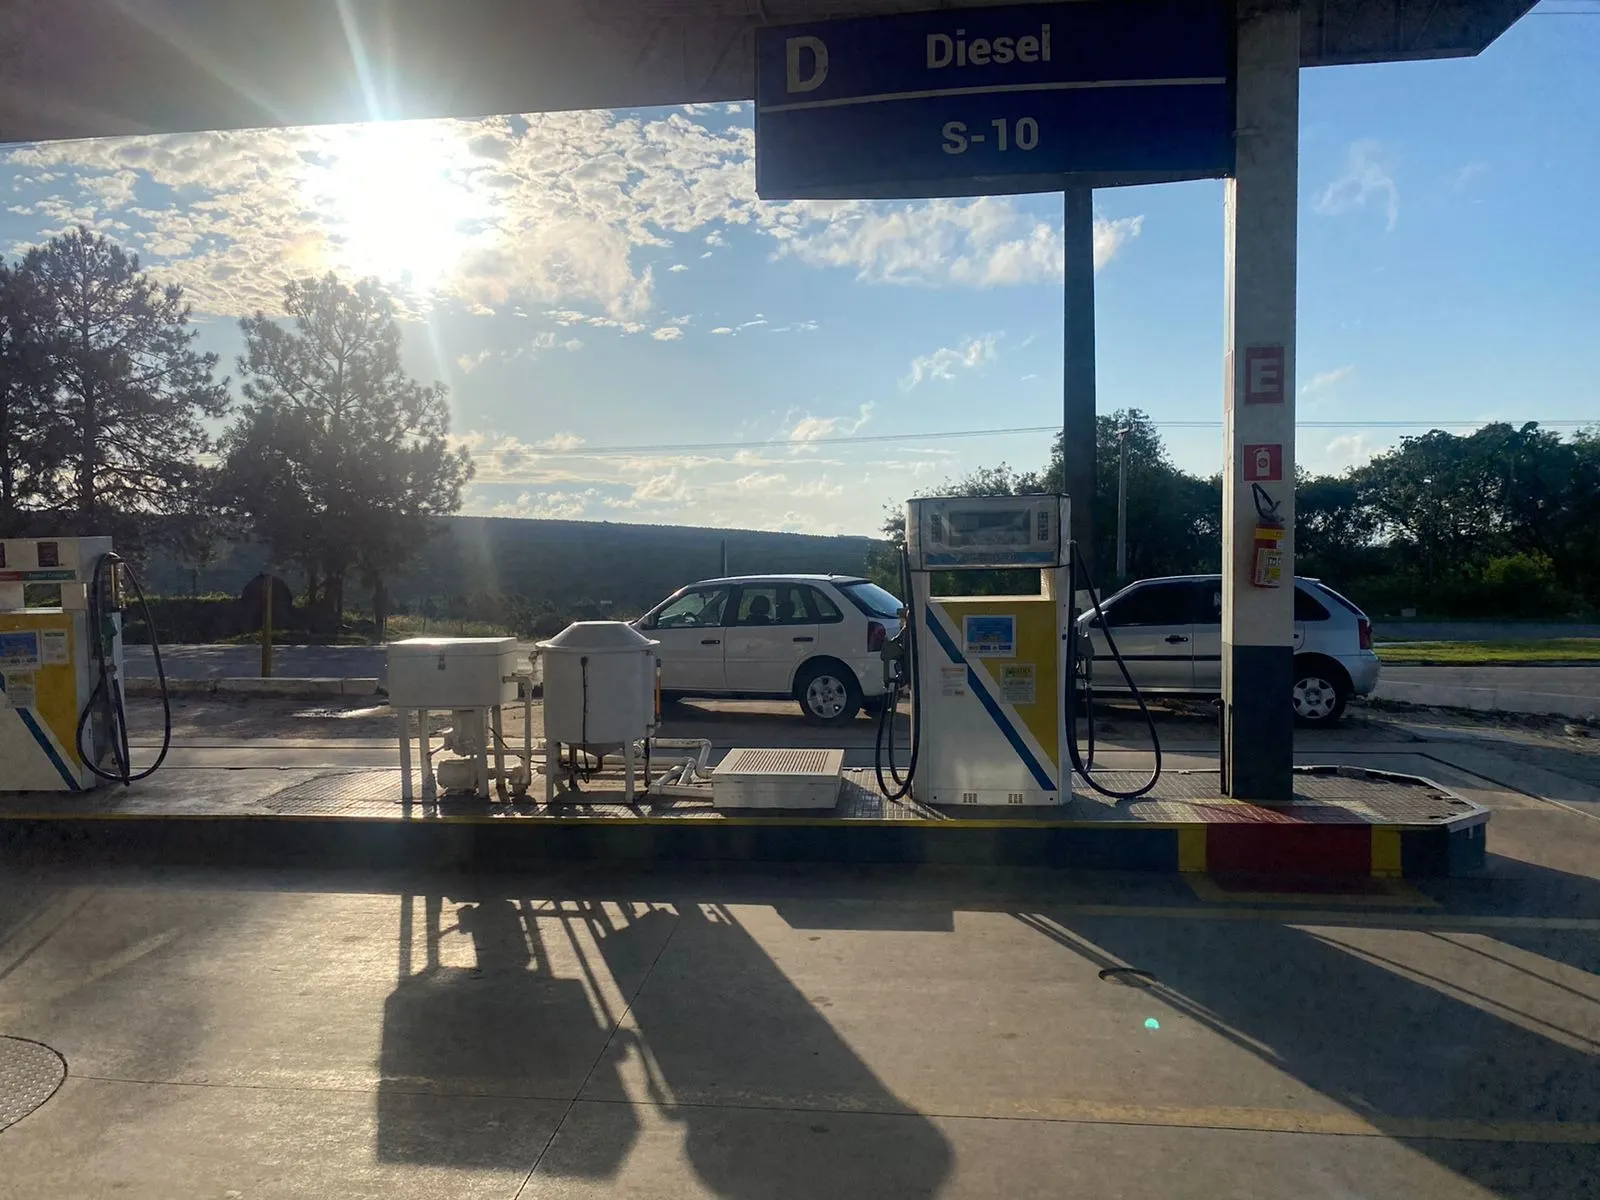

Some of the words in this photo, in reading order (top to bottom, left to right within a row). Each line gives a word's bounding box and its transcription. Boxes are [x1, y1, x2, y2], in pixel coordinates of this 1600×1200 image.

[785, 35, 829, 93] D
[927, 24, 1051, 68] Diesel
[941, 117, 1039, 155] S-10
[1251, 358, 1279, 393] E
